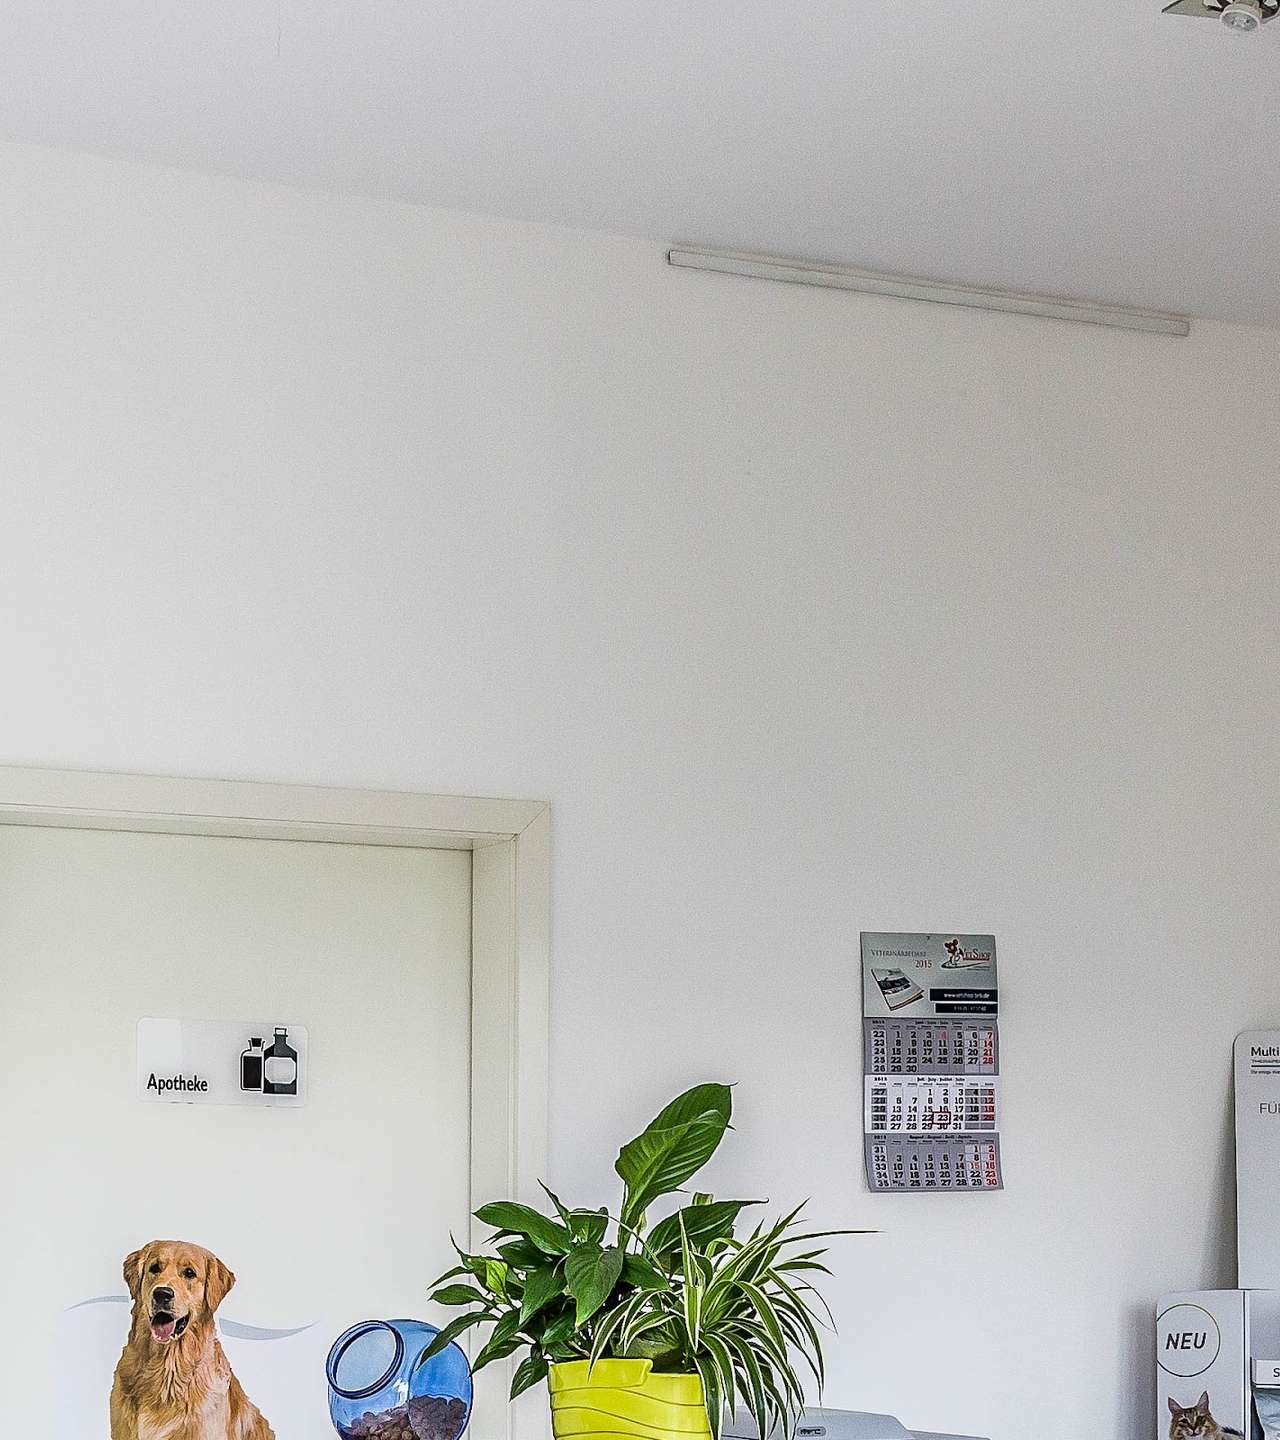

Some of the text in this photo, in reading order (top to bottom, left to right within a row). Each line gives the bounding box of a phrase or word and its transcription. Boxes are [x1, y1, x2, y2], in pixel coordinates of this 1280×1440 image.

[915, 960, 932, 968] 2015
[147, 1073, 208, 1095] Apotheke
[1166, 1333, 1206, 1351] NEU
